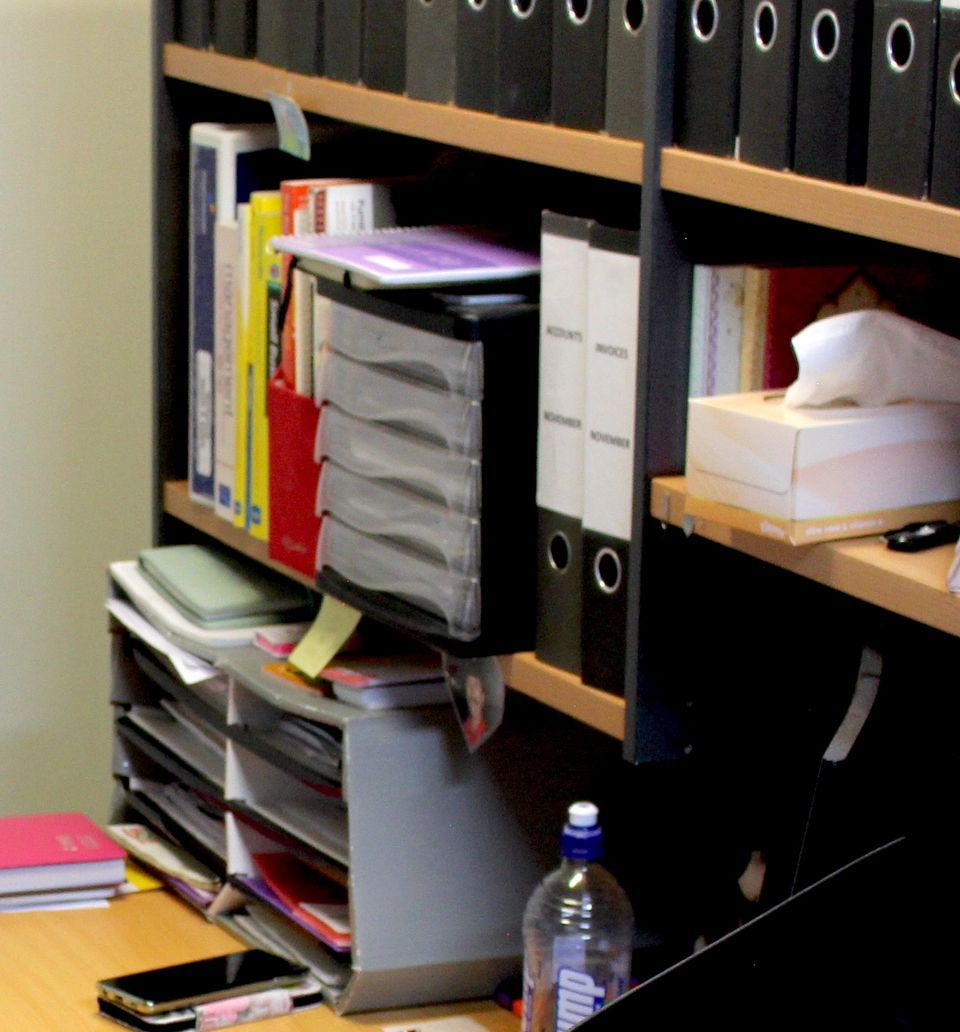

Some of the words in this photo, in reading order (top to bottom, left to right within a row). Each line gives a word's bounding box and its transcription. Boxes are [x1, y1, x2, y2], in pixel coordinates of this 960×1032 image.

[547, 326, 582, 342] ACCOUNTS
[596, 343, 628, 359] INVOICES
[544, 411, 581, 429] NOVEMBER
[590, 430, 629, 449] NOVEMBER
